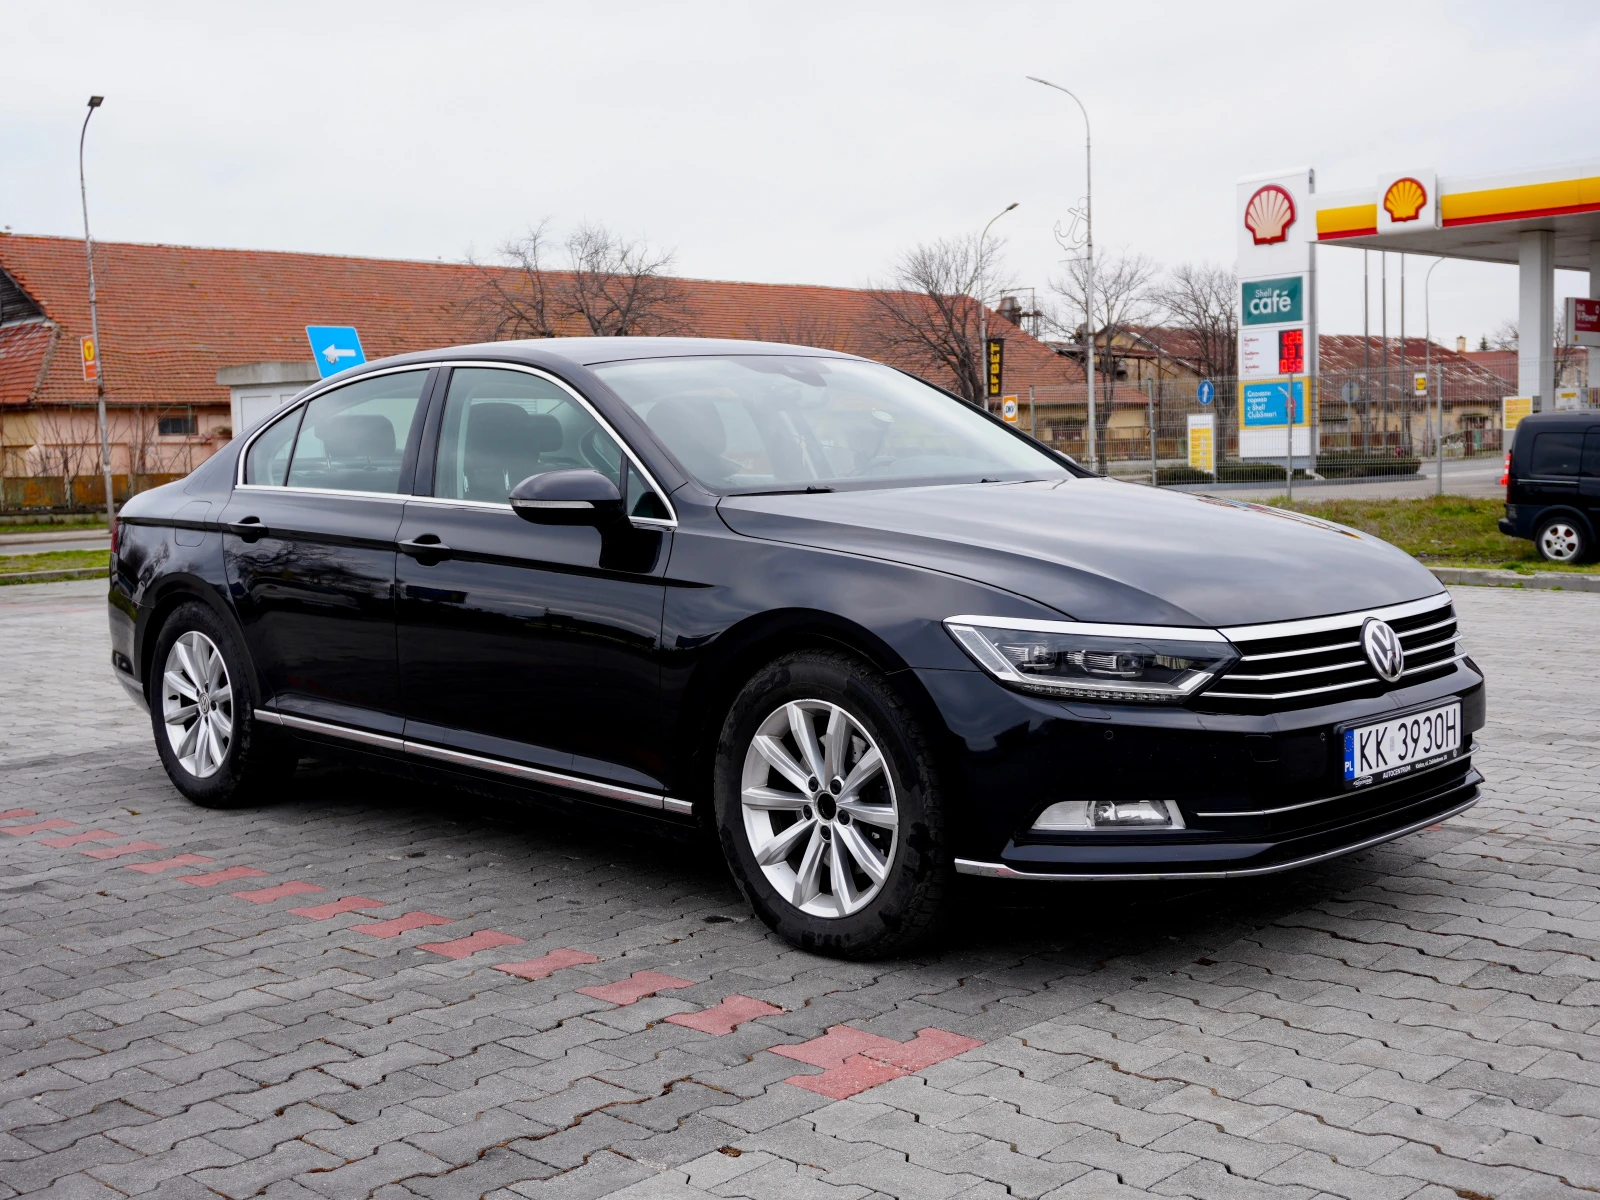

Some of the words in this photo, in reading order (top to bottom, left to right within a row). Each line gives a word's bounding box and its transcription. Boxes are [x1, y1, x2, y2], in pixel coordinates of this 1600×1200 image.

[1255, 288, 1271, 298] Shell
[1250, 290, 1291, 314] café
[990, 342, 1000, 394] EFBET
[1248, 411, 1277, 419] ClubSmart
[1360, 727, 1388, 772] KK
[1398, 708, 1456, 760] 3930H
[1344, 761, 1353, 773] PL
[1383, 765, 1411, 779] AUTOCENTRUM
